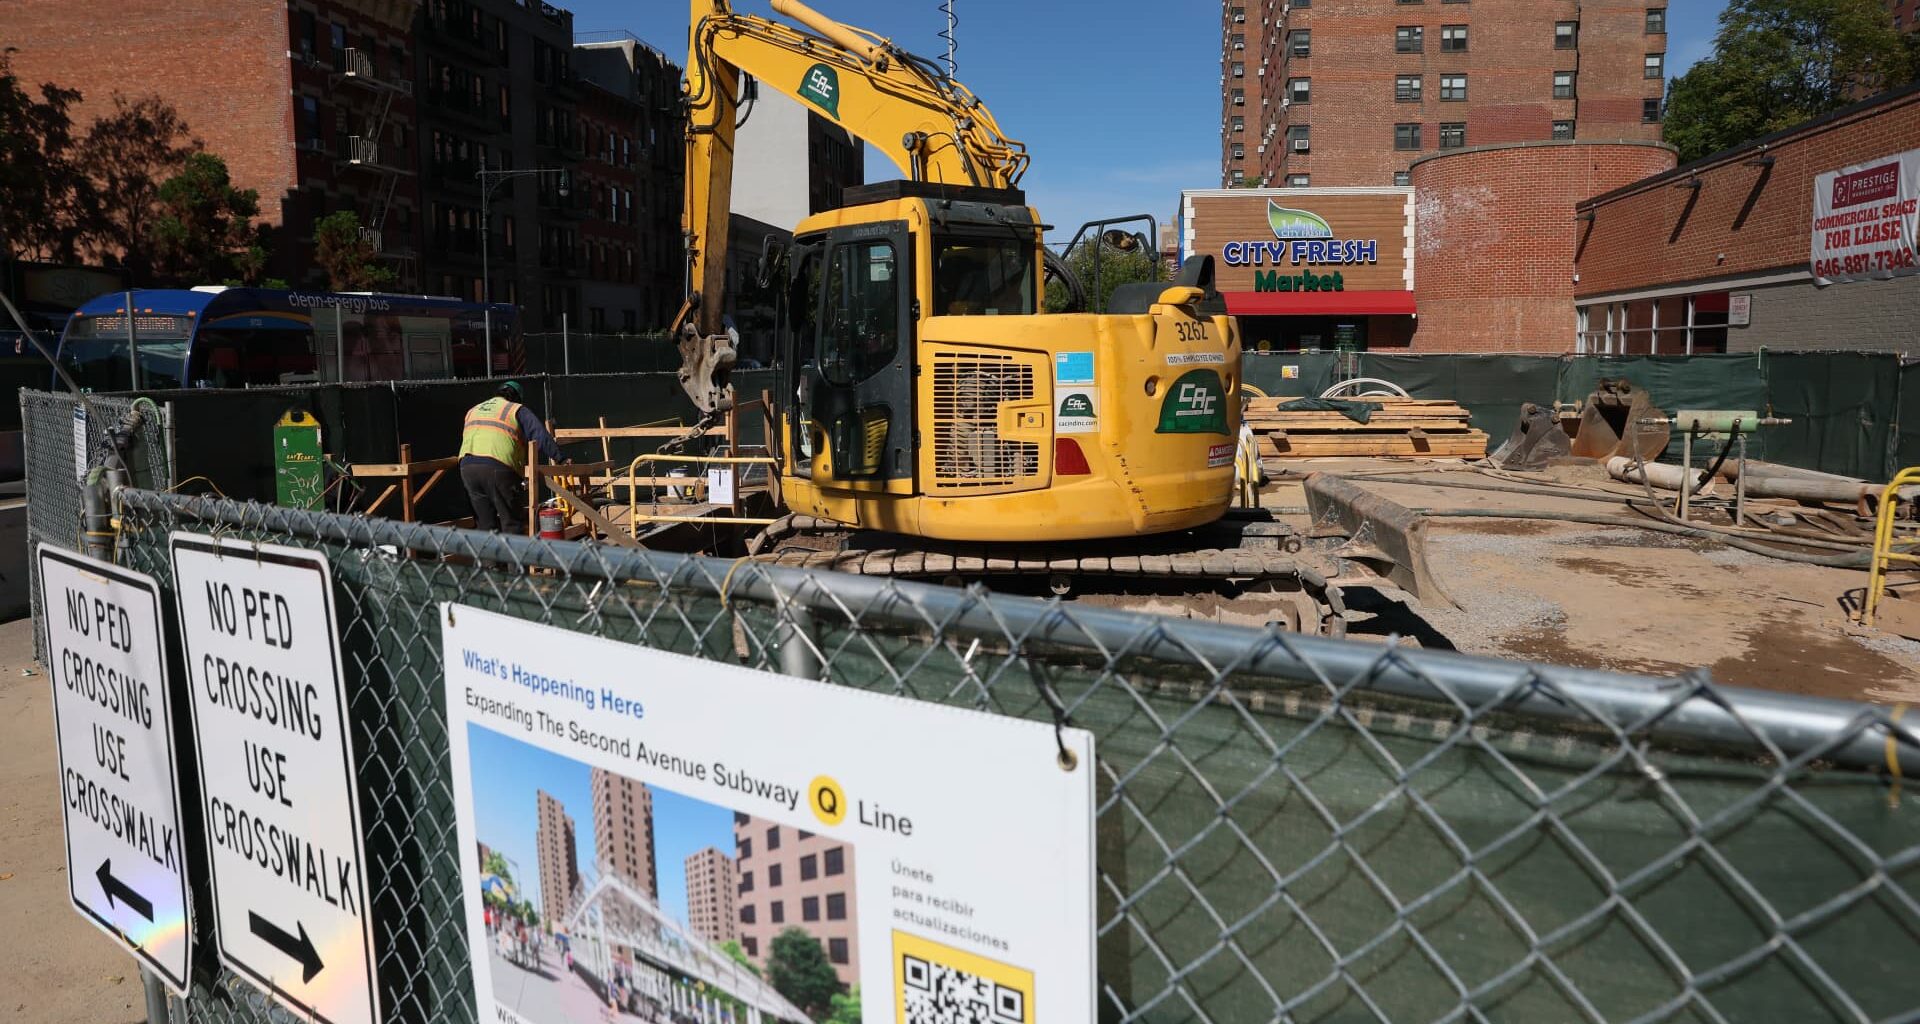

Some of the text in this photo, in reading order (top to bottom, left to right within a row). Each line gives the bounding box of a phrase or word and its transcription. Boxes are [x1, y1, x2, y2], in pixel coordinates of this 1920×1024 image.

[811, 69, 832, 98] CAC
[1852, 171, 1895, 191] PRESTIGE
[1814, 199, 1917, 231] COMMERCIAL SPACE
[1825, 220, 1901, 250] FOR LEASE
[1223, 239, 1377, 264] CITY FRESH
[1815, 246, 1915, 278] 646-887-7342
[1255, 269, 1344, 292] Market
[368, 296, 390, 311] bus
[1175, 320, 1208, 341] 3262
[1067, 398, 1087, 410] CAC
[1179, 383, 1216, 415] CAC
[65, 587, 132, 653] NO PED
[206, 580, 292, 650] NO PED
[63, 648, 151, 730] CROSSING
[204, 653, 322, 741] CROSSING
[463, 648, 644, 719] What's Happening Here
[93, 723, 130, 782] USE
[466, 687, 912, 836] Expanding The Second Avenue Subway Q Line
[244, 740, 292, 808] USE
[66, 767, 178, 873] CROSSWALK
[211, 797, 357, 916] CROSSWALK
[891, 857, 933, 883] Únete
[892, 885, 974, 917] para recibir
[893, 908, 1009, 951] actualizaciones
